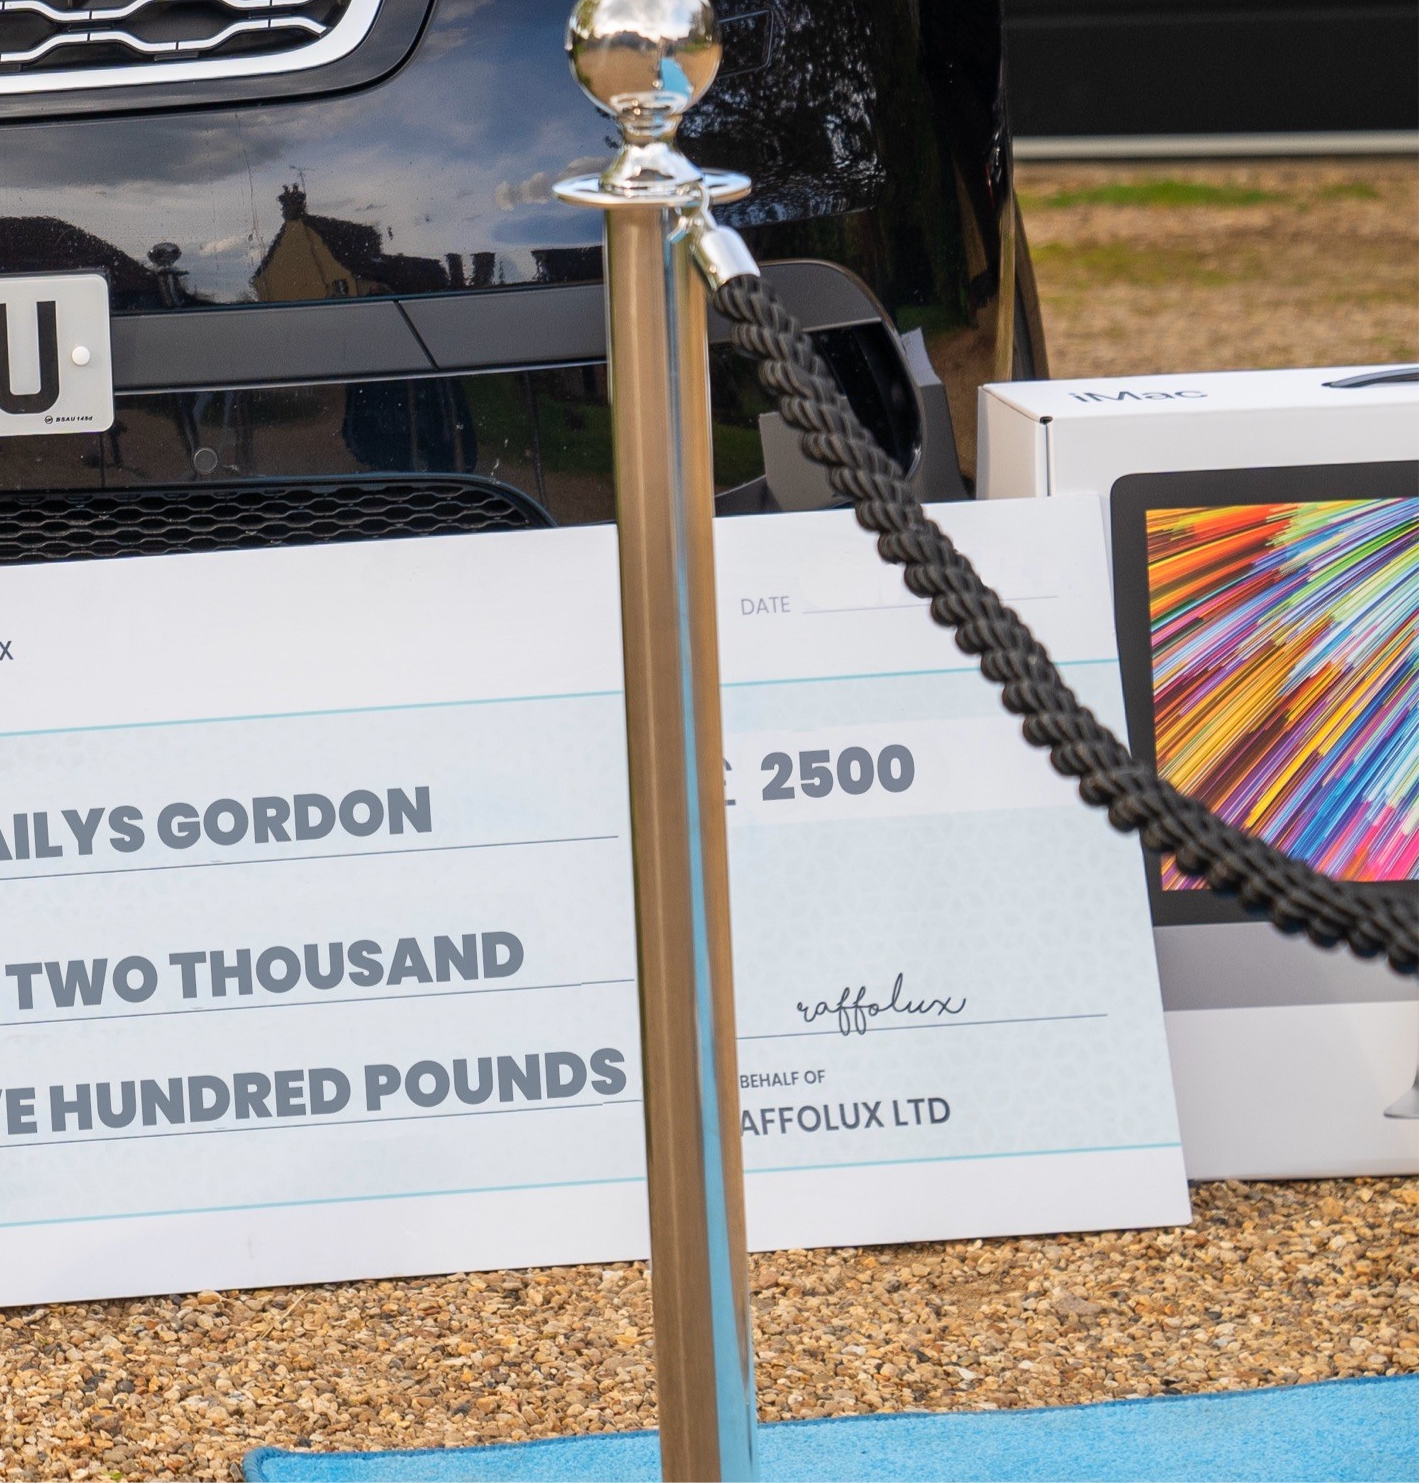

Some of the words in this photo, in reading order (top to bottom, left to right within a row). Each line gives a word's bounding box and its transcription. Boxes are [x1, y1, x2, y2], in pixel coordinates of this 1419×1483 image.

[1068, 388, 1209, 403] iMac
[740, 595, 791, 616] DATE
[761, 744, 915, 801] 2500
[157, 785, 432, 850] GORDON
[6, 956, 157, 1011] TWO
[169, 930, 525, 1000] THOUSAND
[796, 972, 967, 1036] raffolux
[50, 1066, 351, 1133] HUNDRED
[364, 1046, 627, 1113] POUNDS
[740, 1071, 799, 1089] BEHALF
[804, 1069, 826, 1085] OF
[740, 1100, 884, 1137] AFFOLUX
[893, 1097, 951, 1127] LTD
